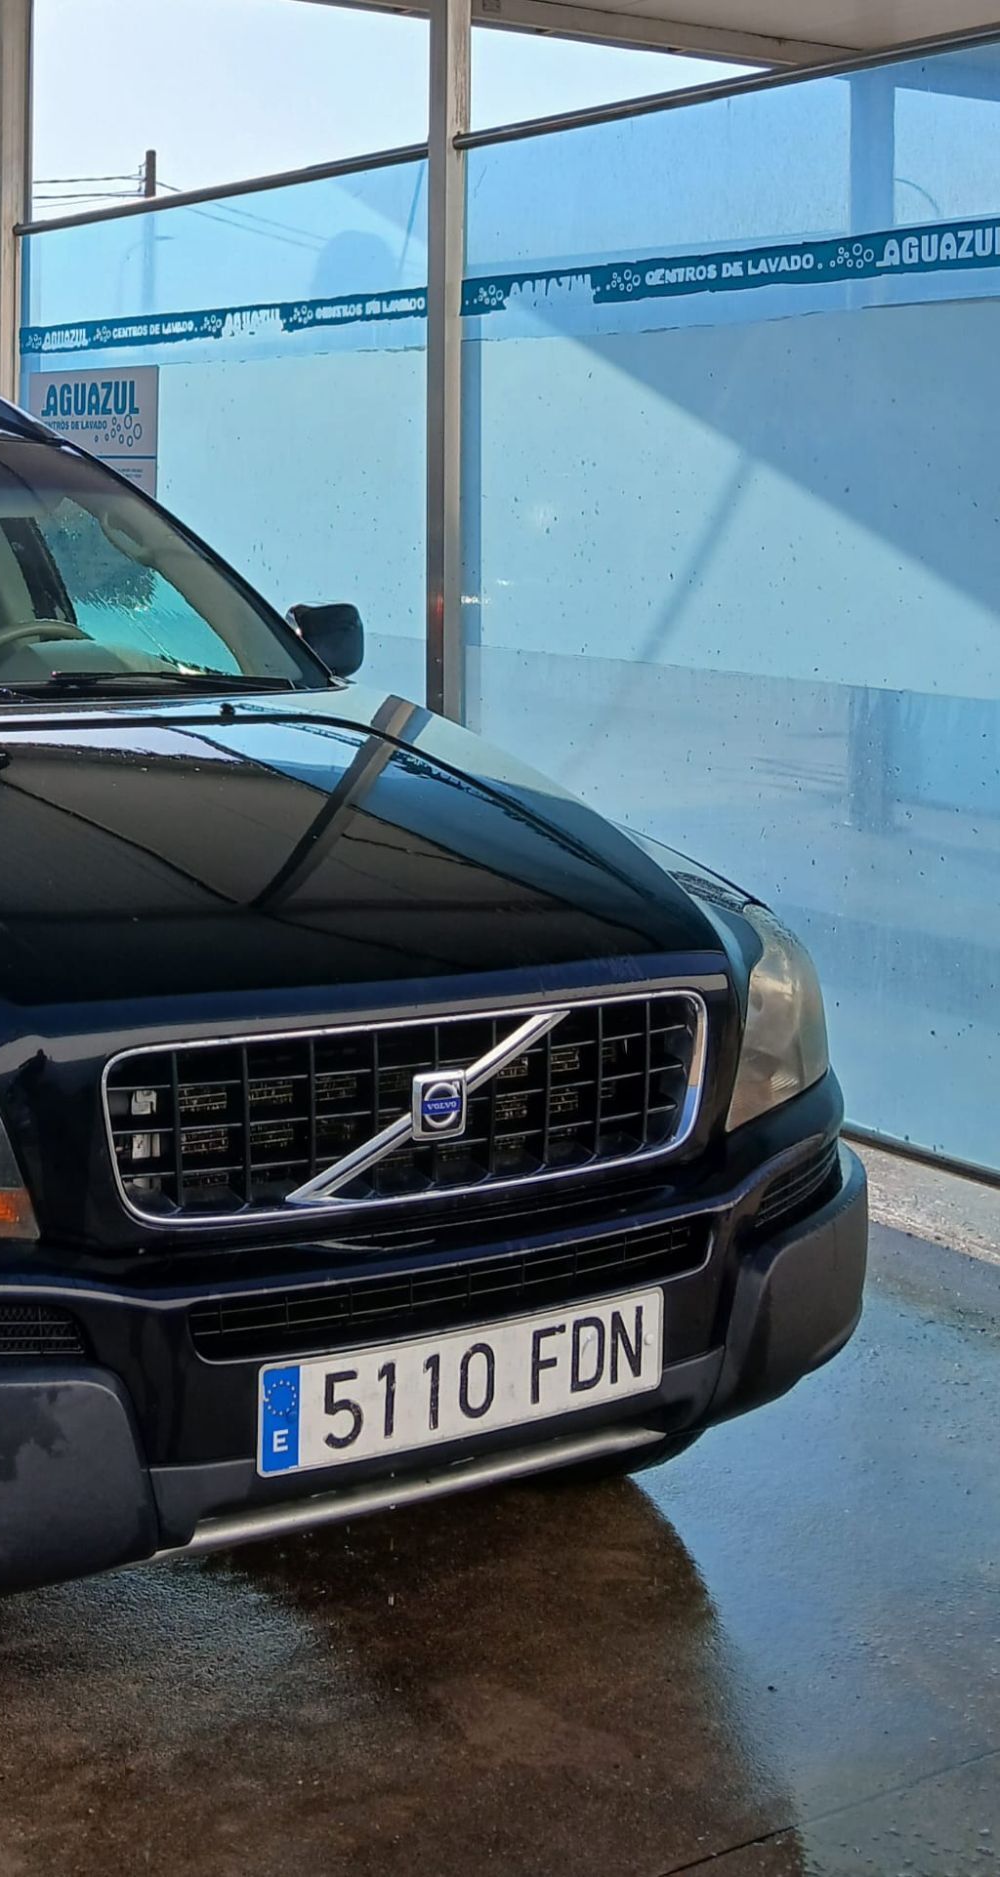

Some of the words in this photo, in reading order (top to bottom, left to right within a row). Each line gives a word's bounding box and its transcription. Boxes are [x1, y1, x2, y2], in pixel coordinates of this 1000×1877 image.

[645, 264, 718, 285] CENTROS
[721, 261, 743, 278] DE
[747, 253, 815, 275] LAVADO
[112, 324, 148, 340] CENTROS
[150, 323, 160, 336] DE
[162, 320, 194, 335] LAVADO
[41, 380, 139, 416] AGUAZUL
[45, 420, 69, 430] NTROS
[71, 421, 79, 430] DE
[81, 420, 107, 430] LAVADO
[426, 1100, 457, 1111] VOLVO
[323, 1342, 495, 1450] 5110
[530, 1305, 643, 1405] FDN
[272, 1429, 289, 1452] E
